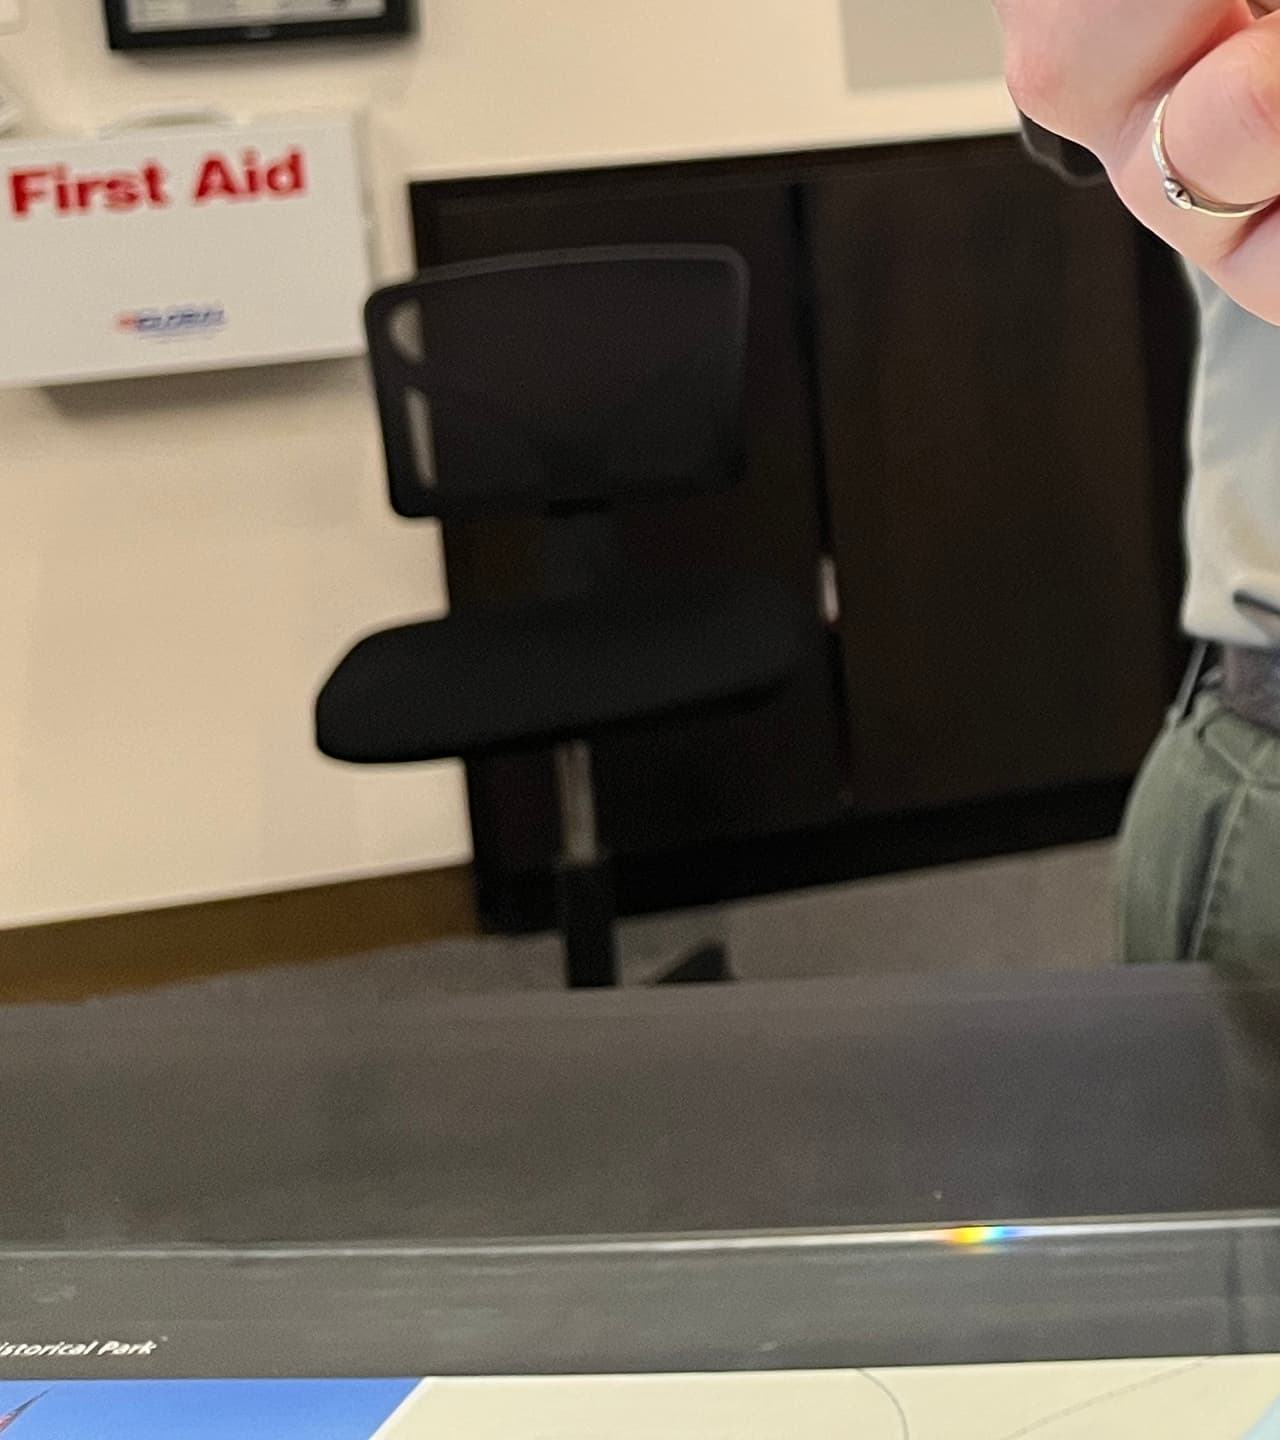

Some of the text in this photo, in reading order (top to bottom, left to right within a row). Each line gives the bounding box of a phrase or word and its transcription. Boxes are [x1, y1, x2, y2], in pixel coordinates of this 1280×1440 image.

[7, 144, 308, 218] First Aid
[97, 1340, 157, 1355] Park
